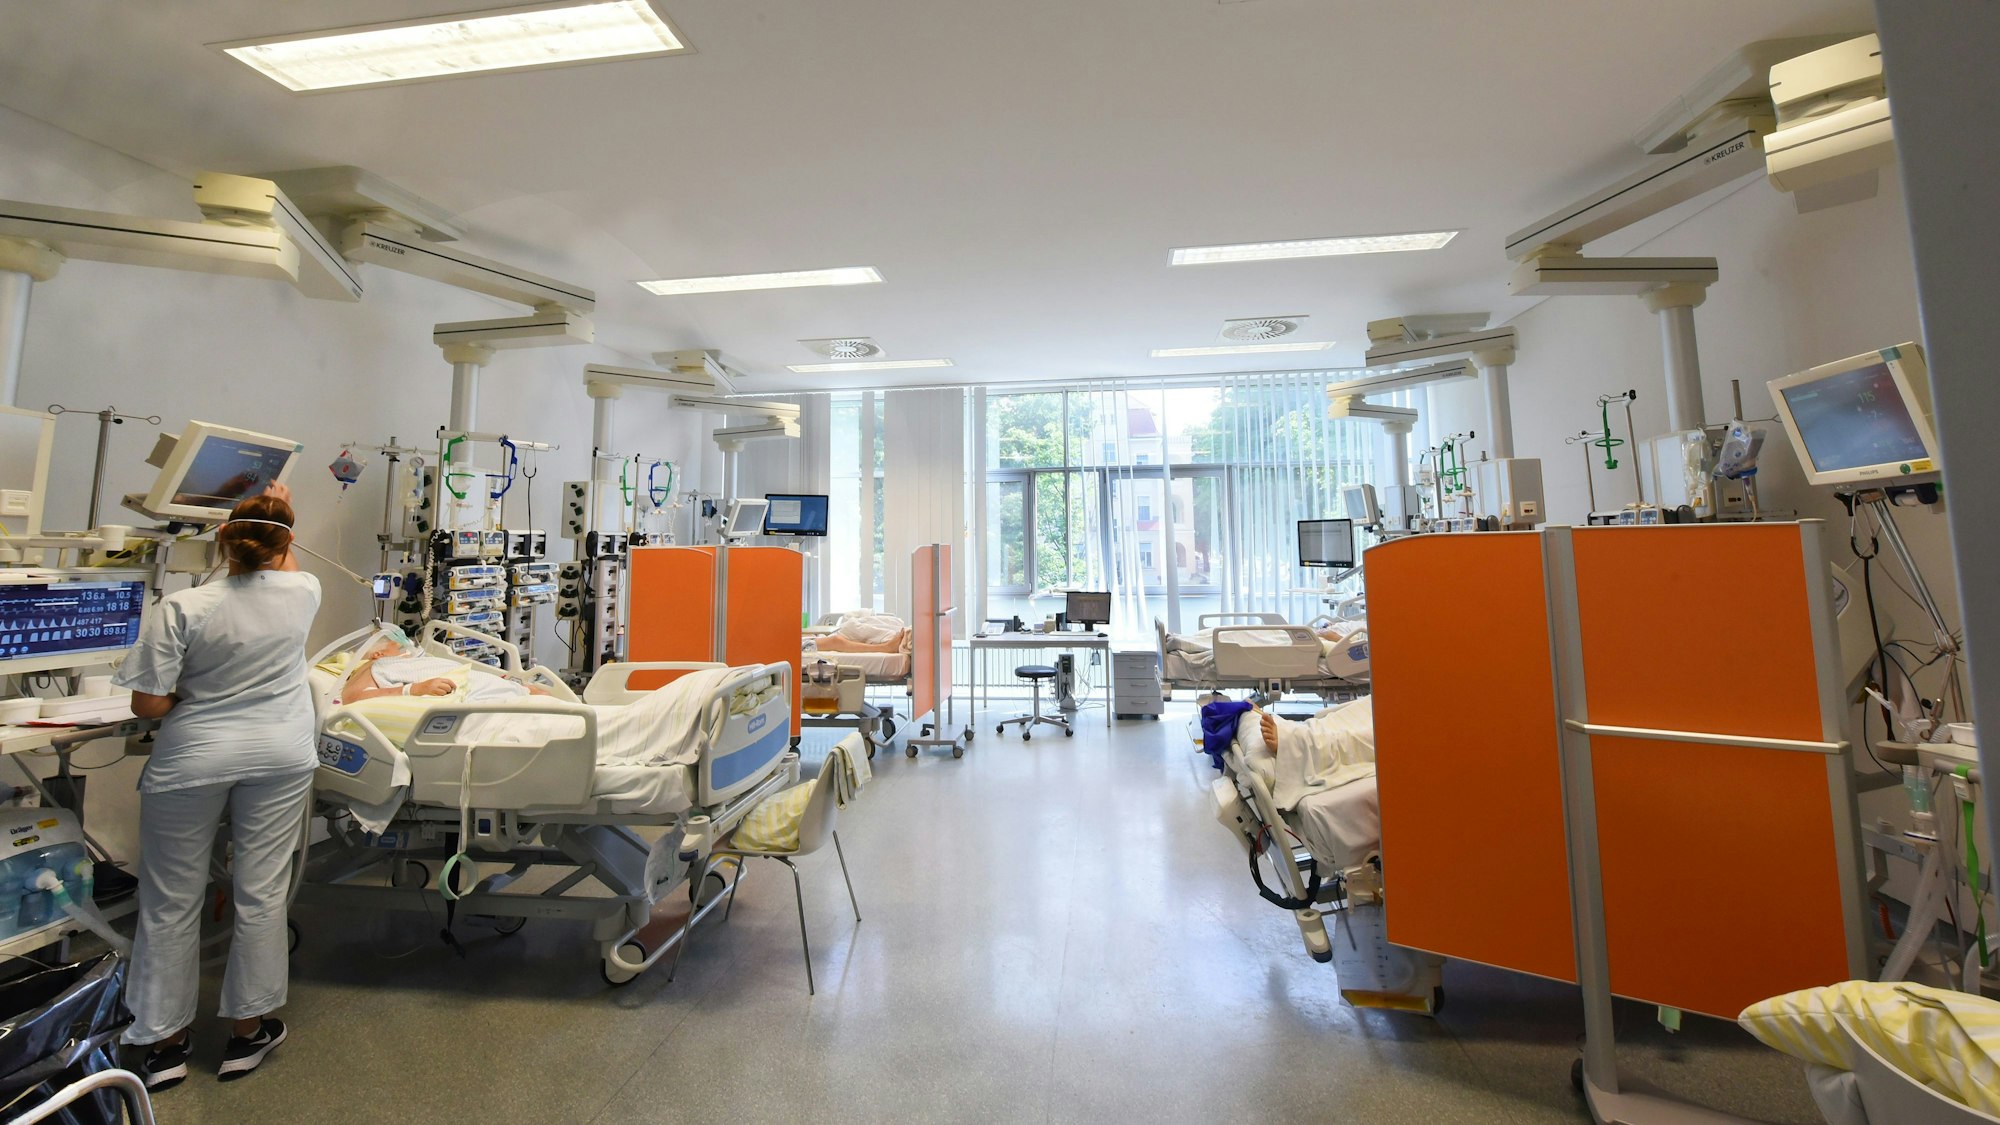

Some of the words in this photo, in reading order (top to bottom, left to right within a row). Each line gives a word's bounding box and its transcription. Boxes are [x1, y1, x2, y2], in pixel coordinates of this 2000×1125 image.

[1711, 141, 1744, 161] KREUZER
[376, 242, 406, 255] KREUZER
[115, 591, 131, 599] 10.5
[106, 602, 117, 611] 18
[119, 601, 130, 610] 18
[76, 628, 88, 637] 30
[88, 627, 101, 637] 30
